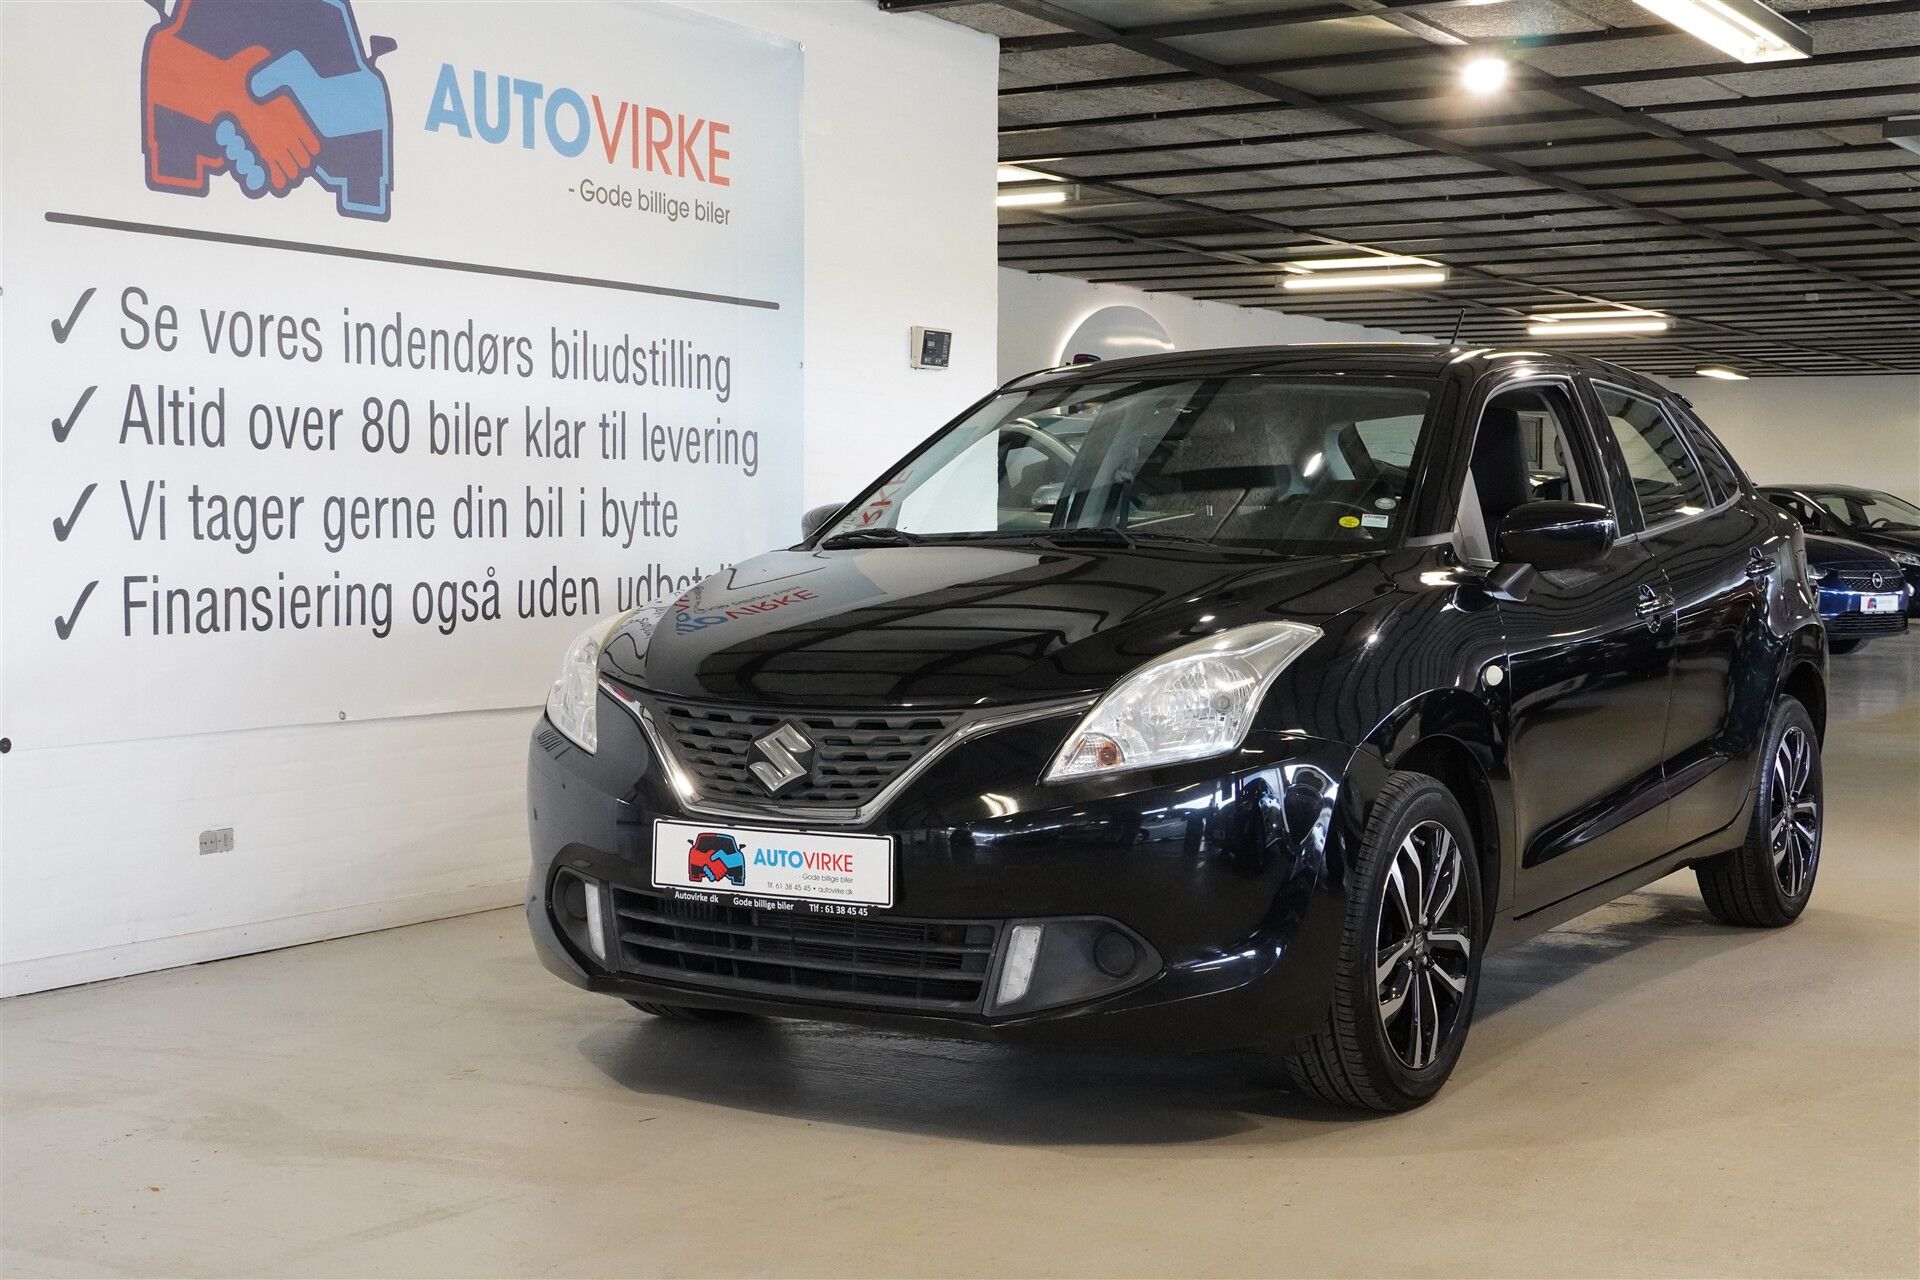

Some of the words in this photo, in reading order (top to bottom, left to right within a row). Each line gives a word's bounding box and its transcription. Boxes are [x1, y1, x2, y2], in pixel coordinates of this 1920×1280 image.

[425, 63, 730, 187] AUTOVIRKE
[580, 178, 632, 209] Gode
[638, 188, 690, 222] billige
[695, 199, 730, 226] biler
[120, 287, 178, 353] Se
[200, 308, 323, 363] vores
[344, 306, 534, 378] indendørs
[552, 326, 731, 404] biludstilling
[119, 384, 226, 449] Altid
[248, 403, 343, 456] over
[362, 397, 411, 455] 80
[430, 399, 508, 457] biler
[526, 405, 585, 461] klar
[599, 412, 627, 461] til
[643, 412, 759, 478] levering
[120, 480, 167, 541] Vi
[188, 485, 304, 555] tager
[323, 496, 436, 553] gerne
[454, 484, 508, 540] din
[526, 485, 563, 539] bil
[581, 486, 587, 538] i
[602, 487, 678, 558] bytte
[123, 571, 393, 639] Finansiering
[413, 565, 500, 636] også
[518, 565, 601, 620] uden
[753, 848, 853, 872] AUTOVIRKE
[803, 873, 820, 881] Gode
[675, 891, 708, 902] Autovirke
[733, 897, 753, 908] Gode
[754, 899, 776, 910] billige
[777, 901, 794, 910] biler
[825, 905, 834, 914] 61
[836, 906, 846, 914] 38
[847, 907, 857, 915] 45
[858, 908, 868, 916] 45
